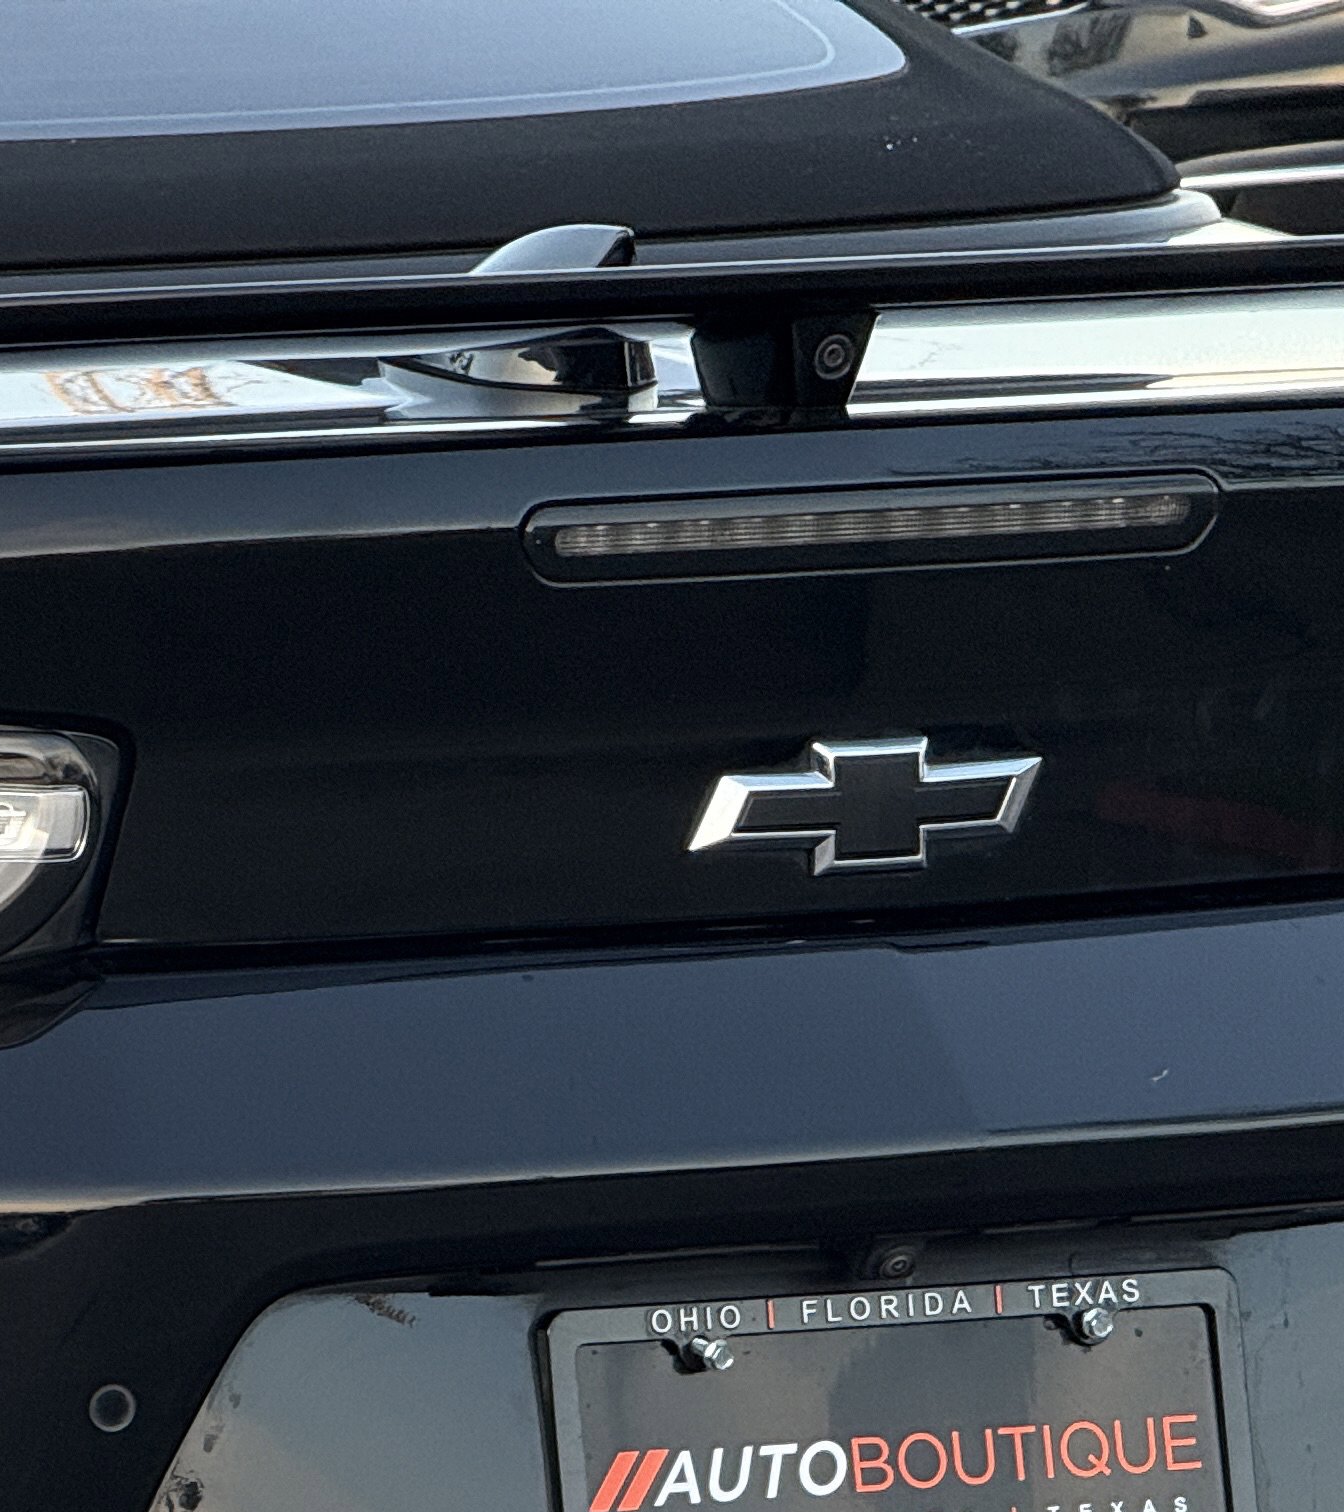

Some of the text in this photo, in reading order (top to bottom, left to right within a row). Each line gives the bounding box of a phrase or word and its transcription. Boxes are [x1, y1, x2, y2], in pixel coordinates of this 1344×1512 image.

[650, 1278, 1141, 1333] OHIO FLORIDA TEXAS
